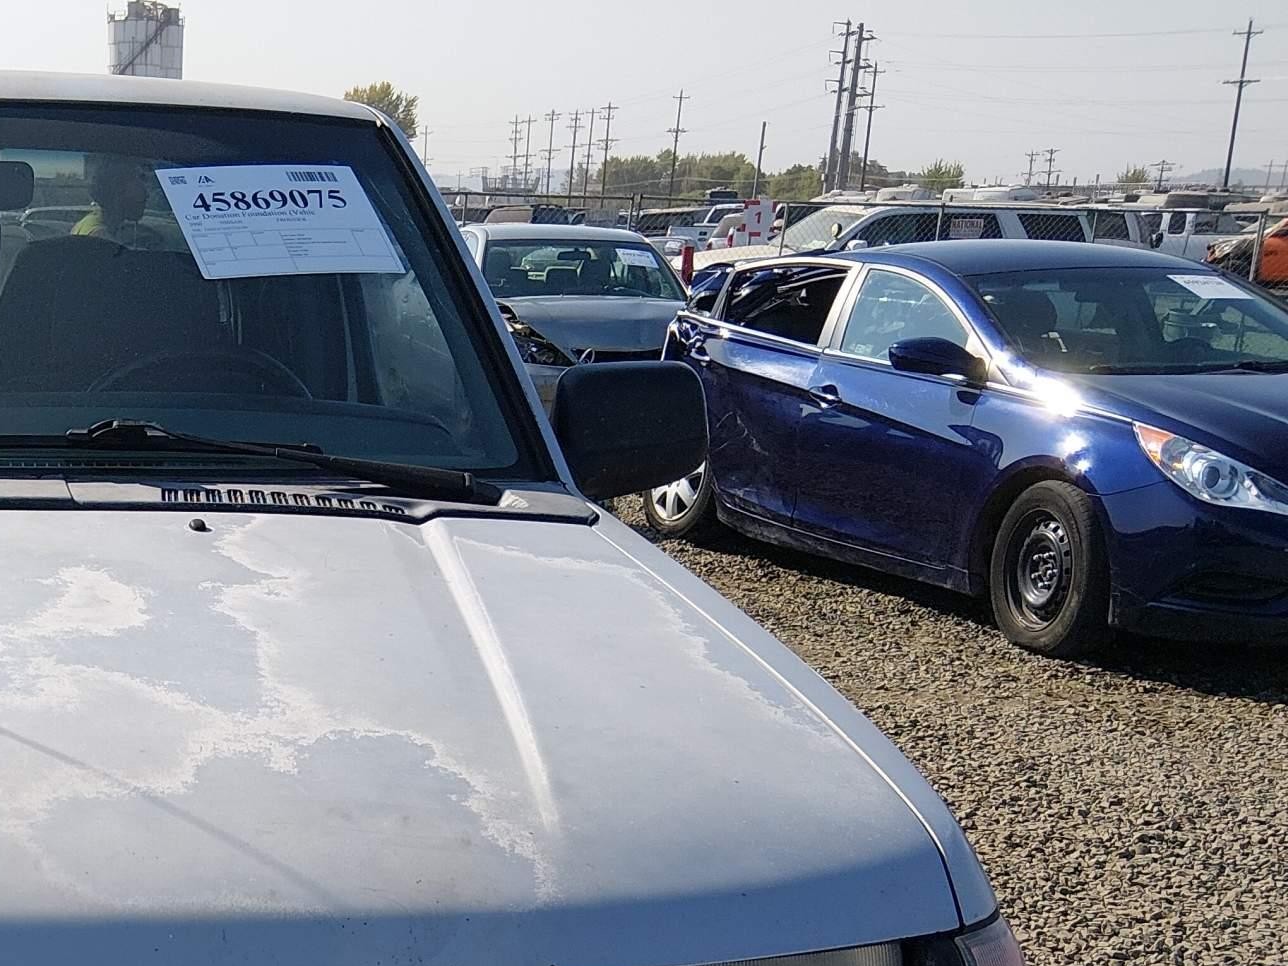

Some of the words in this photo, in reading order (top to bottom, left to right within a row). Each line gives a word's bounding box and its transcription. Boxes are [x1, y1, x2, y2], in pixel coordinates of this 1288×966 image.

[192, 188, 348, 212] 45869075
[202, 211, 241, 220] Donation
[242, 209, 288, 218] Foundation
[754, 211, 762, 224] 1
